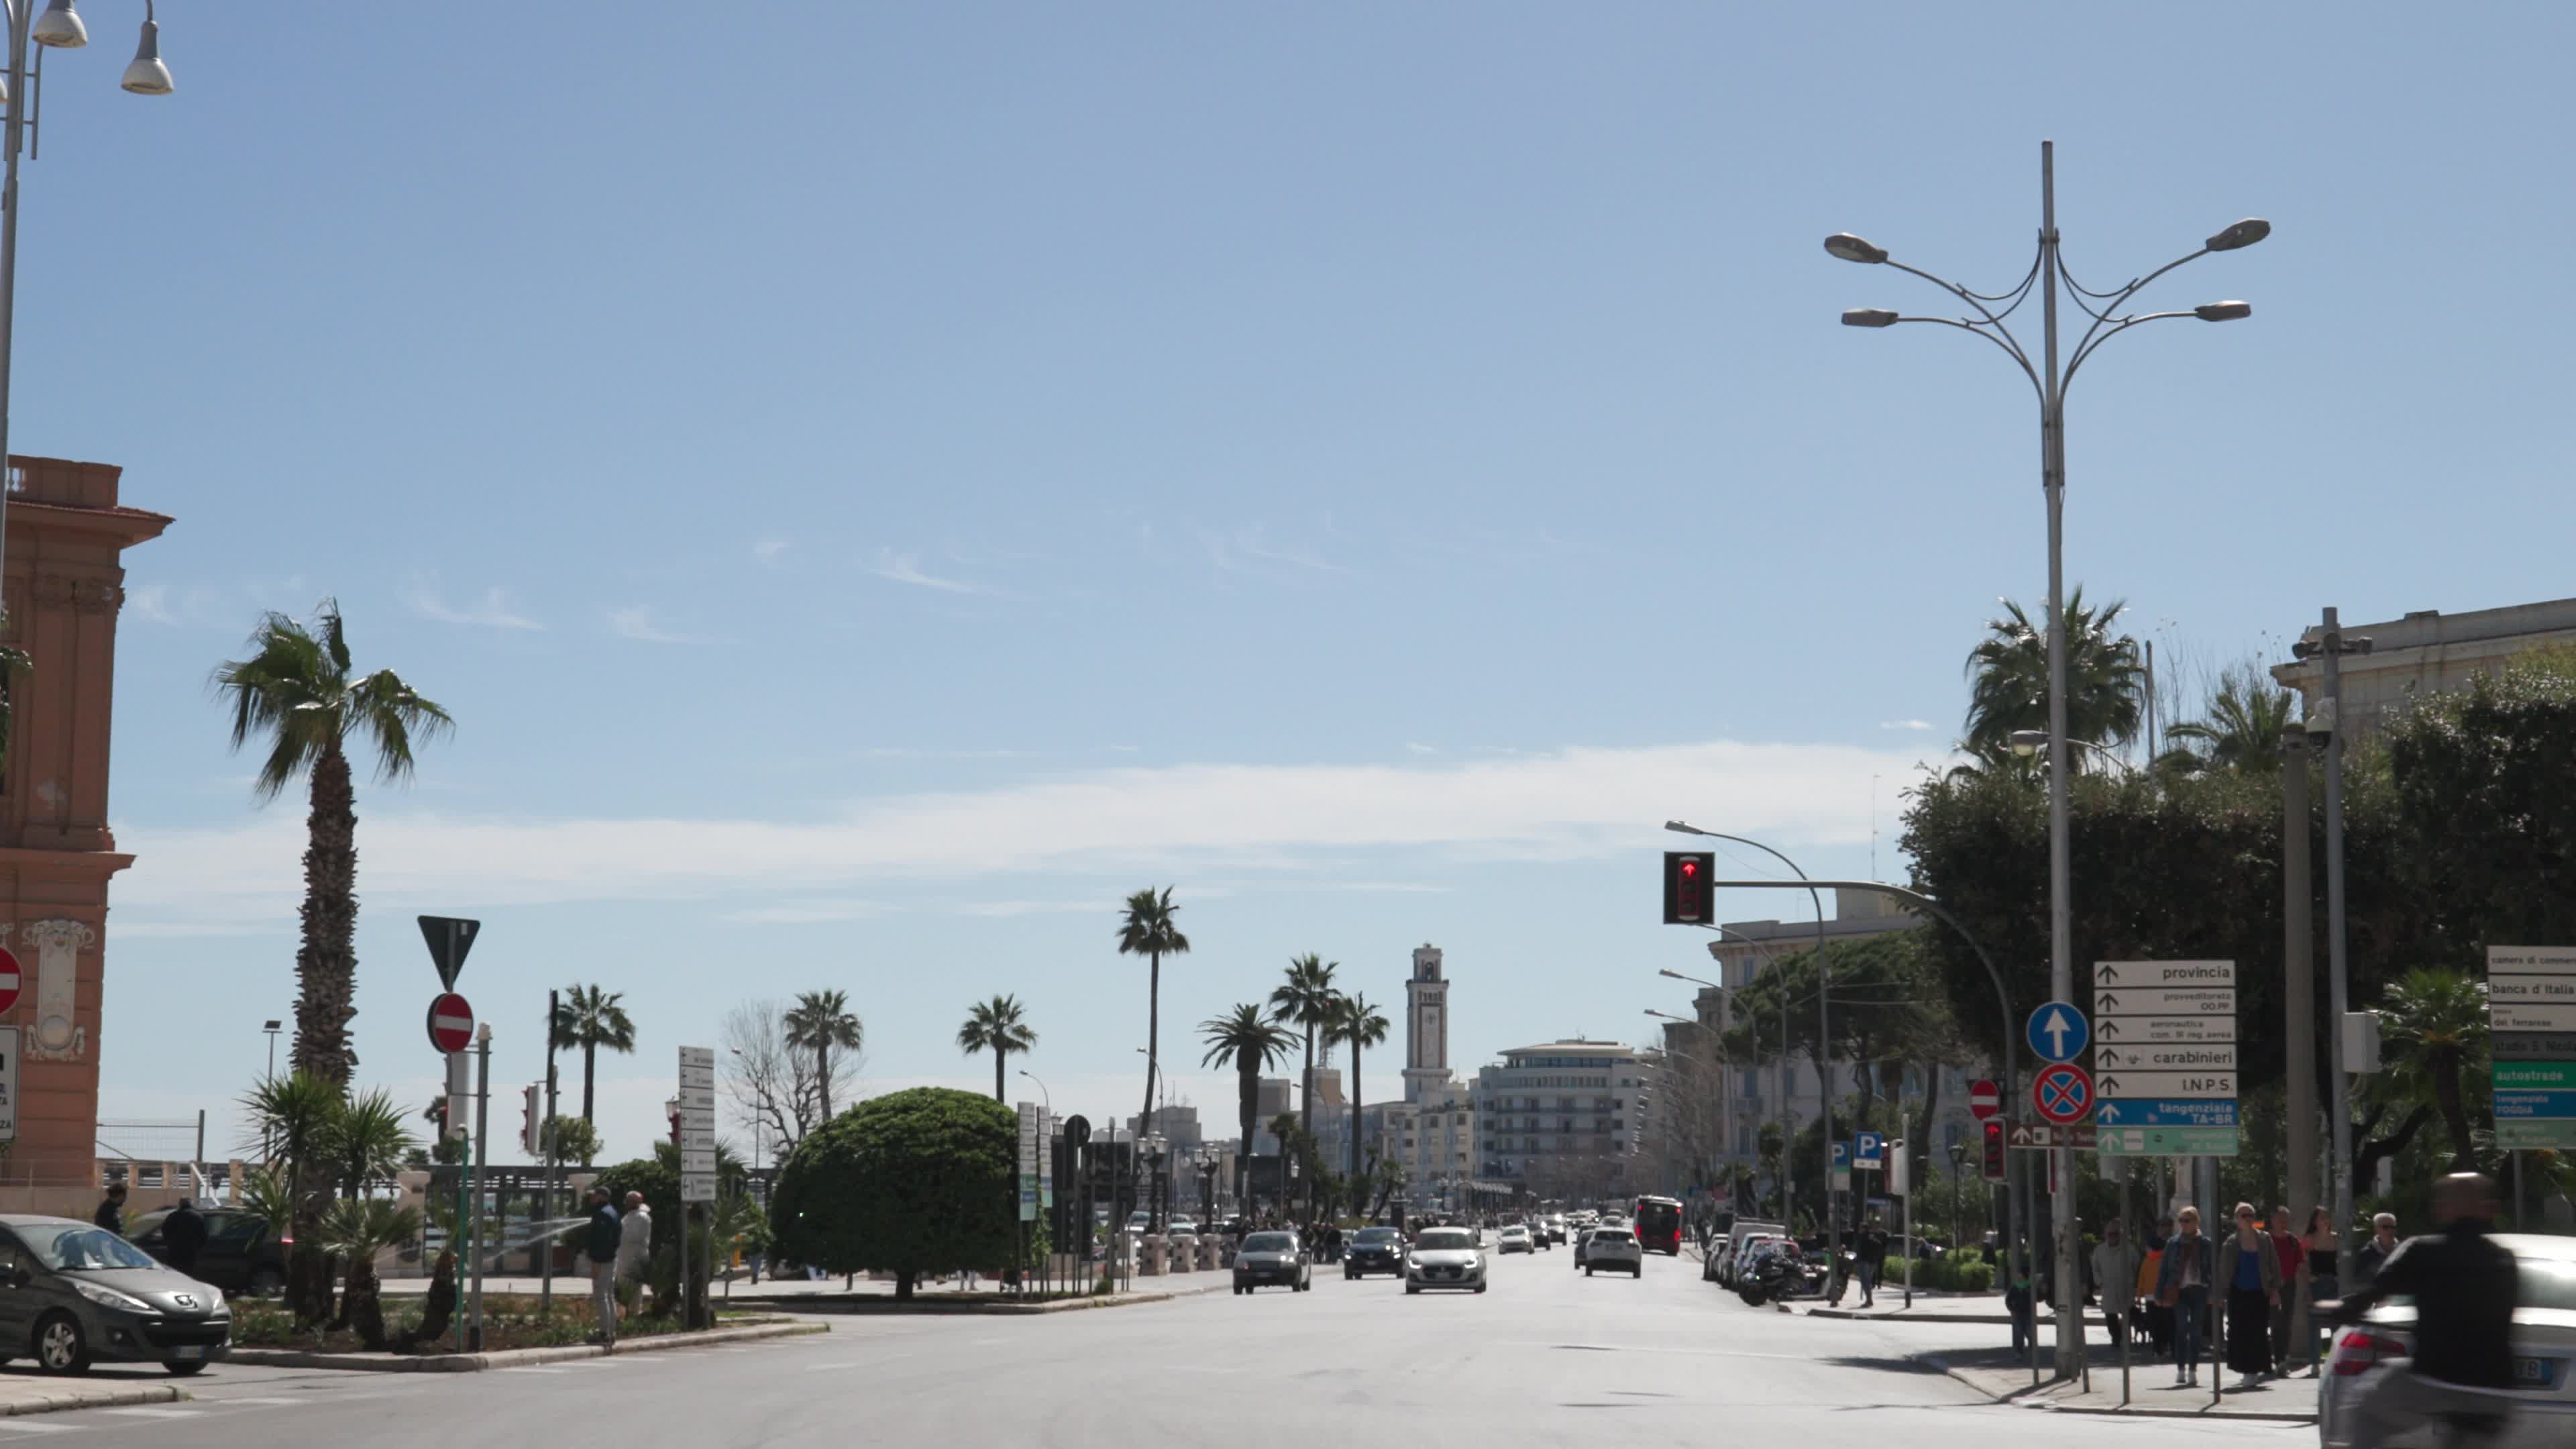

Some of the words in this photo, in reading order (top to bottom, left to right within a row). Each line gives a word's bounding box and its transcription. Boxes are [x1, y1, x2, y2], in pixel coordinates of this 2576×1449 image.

[2162, 966, 2231, 981] provincia
[2491, 983, 2527, 994] banca
[2153, 1051, 2233, 1064] carabinieri
[2182, 1079, 2233, 1092] I.N.P.S.
[2159, 1102, 2234, 1116] tangenziale
[2192, 1114, 2233, 1124] TA-BR
[1859, 1135, 1876, 1157] P
